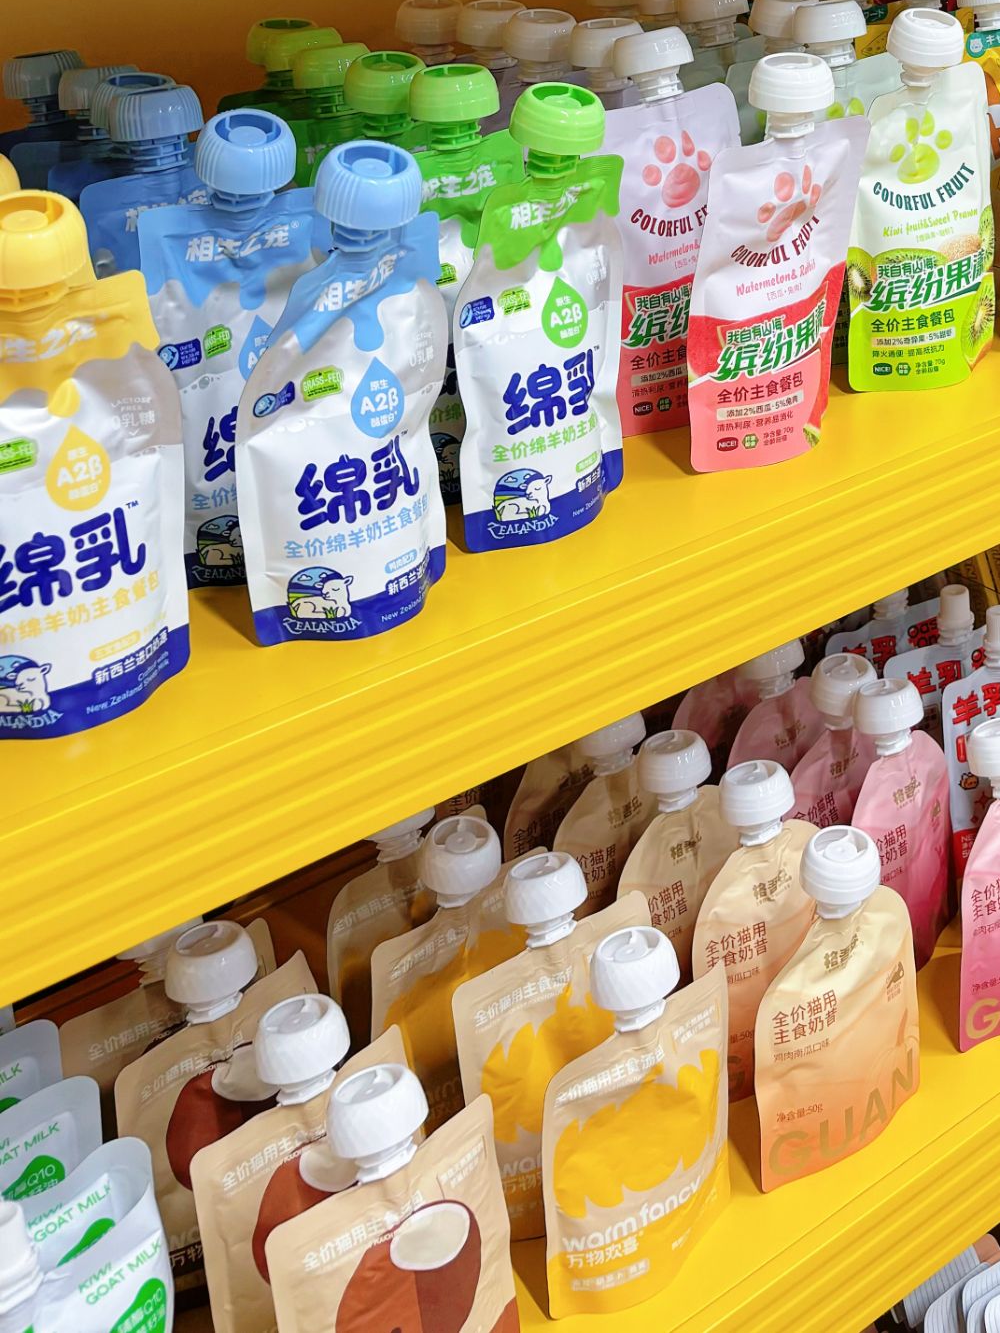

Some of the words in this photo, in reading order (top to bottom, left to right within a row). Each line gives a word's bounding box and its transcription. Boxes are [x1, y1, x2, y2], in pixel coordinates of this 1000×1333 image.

[872, 180, 936, 212] COLORFUL
[936, 162, 975, 203] FRUIT
[630, 208, 694, 238] COLORFUL
[882, 221, 904, 238] Kiwi
[730, 244, 791, 268] COLORFUL
[877, 257, 936, 279] 我自有山海
[870, 308, 955, 334] 全价主食餐包
[716, 371, 805, 405] 全价主食餐包
[293, 435, 420, 532] 绵乳
[704, 921, 767, 957] 全价猫用
[706, 937, 769, 969] 主食奶昔
[772, 989, 838, 1030] 全价猫用
[773, 1009, 839, 1046] 主食奶昔
[768, 1047, 914, 1176] GUAN
[23, 1121, 61, 1150] MILK
[26, 1202, 64, 1229] KIWI
[33, 1207, 74, 1244] GOAT
[77, 1181, 112, 1210] MILK
[562, 1212, 639, 1252] warm
[566, 1235, 640, 1270] 万物欢喜
[77, 1262, 113, 1295] KIWI
[85, 1270, 126, 1306] GOAT
[126, 1240, 162, 1273] MILK
